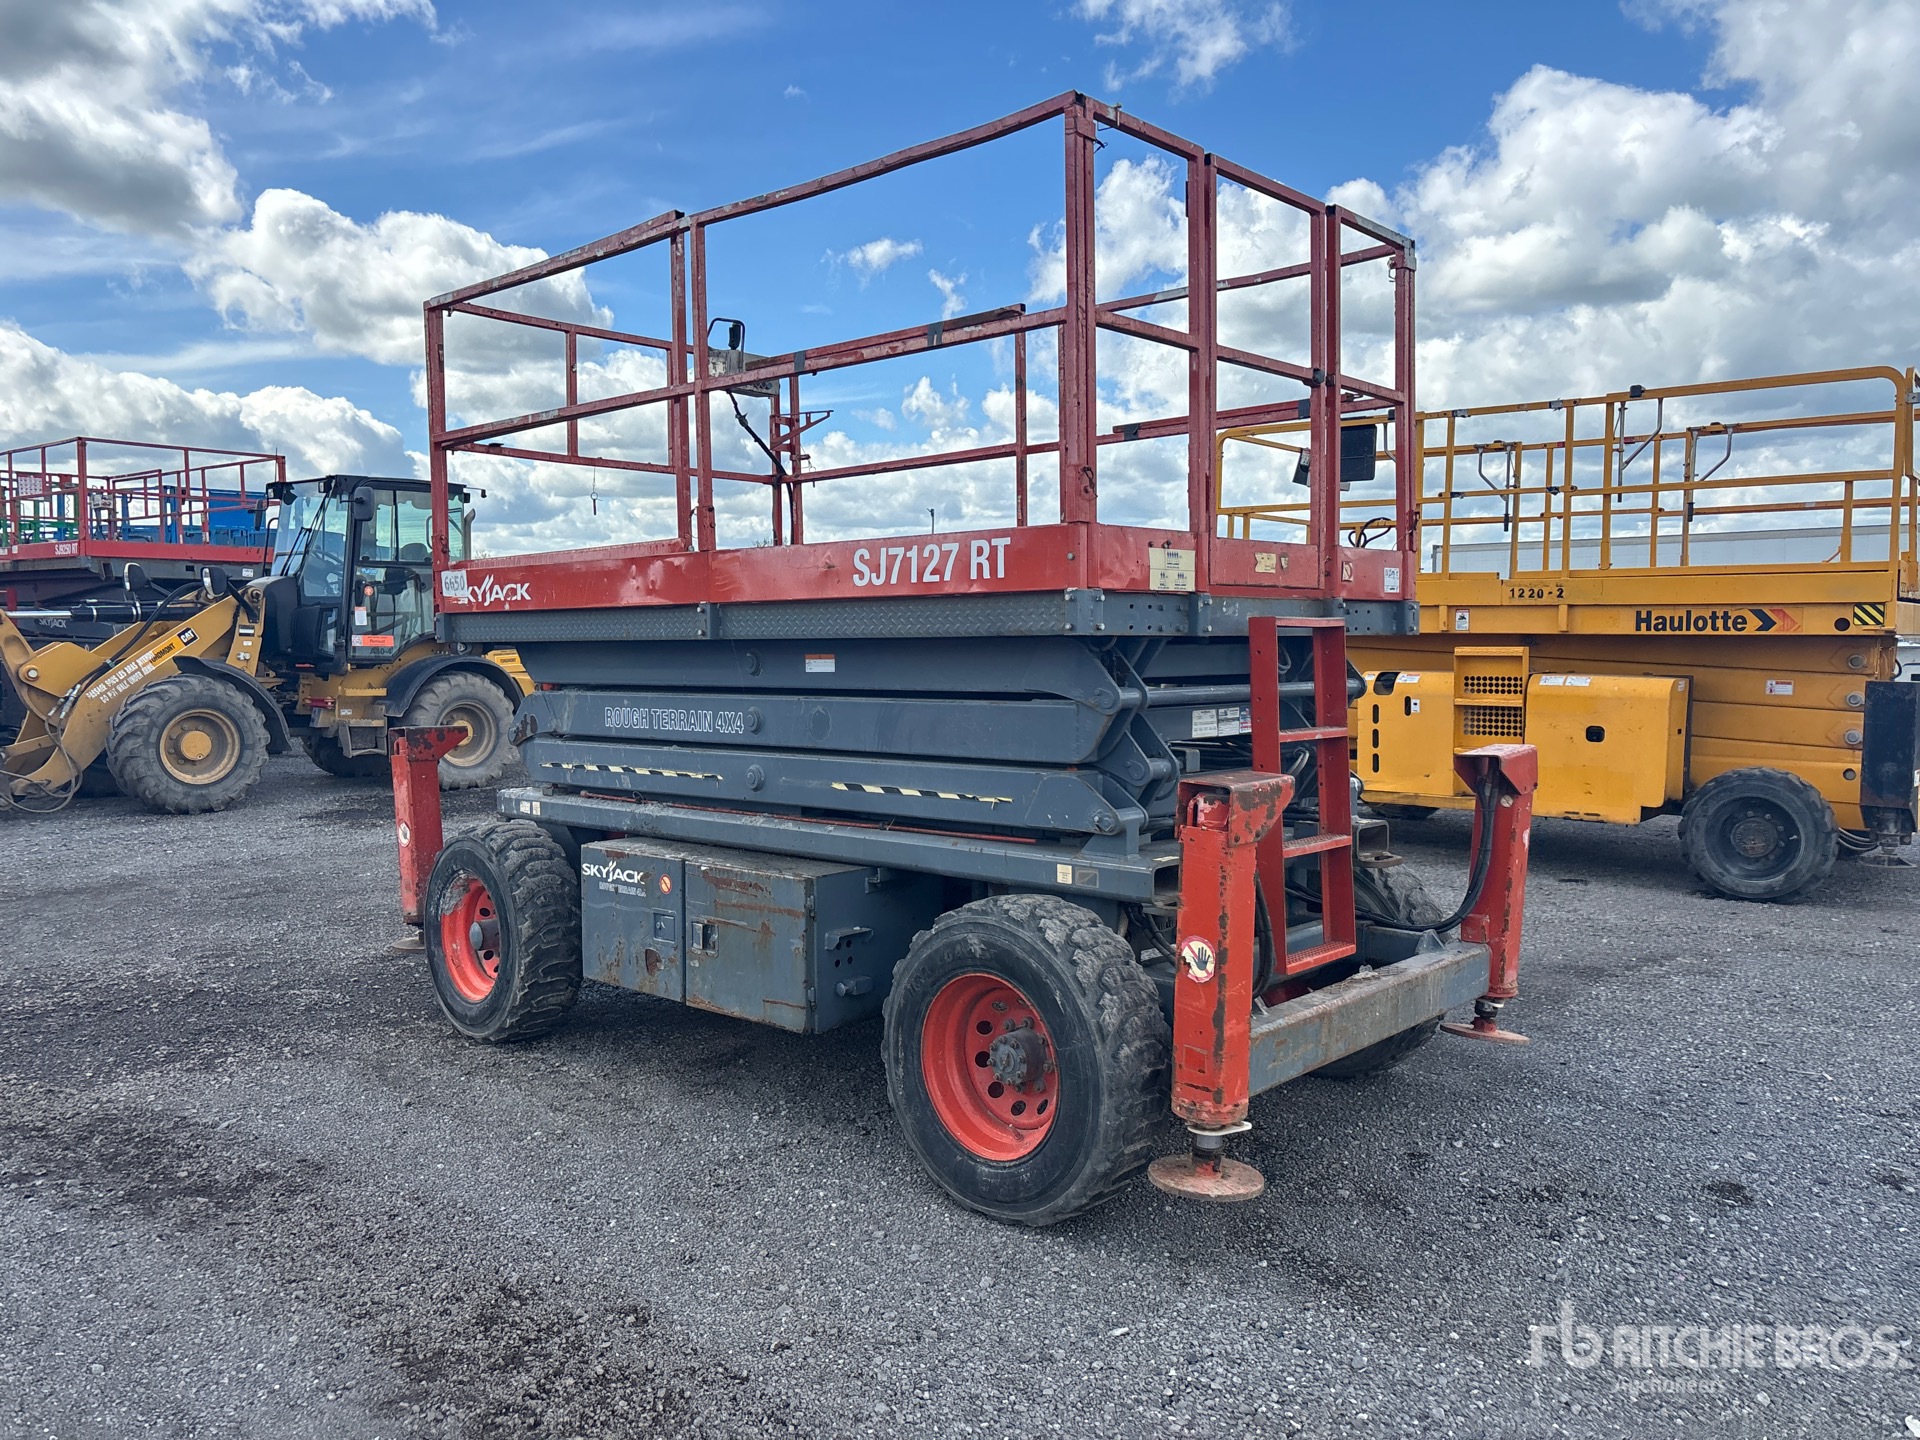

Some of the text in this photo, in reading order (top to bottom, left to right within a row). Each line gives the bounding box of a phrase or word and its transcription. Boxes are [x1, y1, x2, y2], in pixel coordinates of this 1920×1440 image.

[853, 537, 1011, 587] SJ7127 RT
[444, 575, 466, 592] 6650
[457, 574, 532, 606] KYJACK
[1635, 610, 1748, 632] Haulotte
[180, 629, 195, 643] CAT
[604, 706, 745, 734] ROUGH TERRAIN 4X4
[582, 860, 646, 885] SKYJACK
